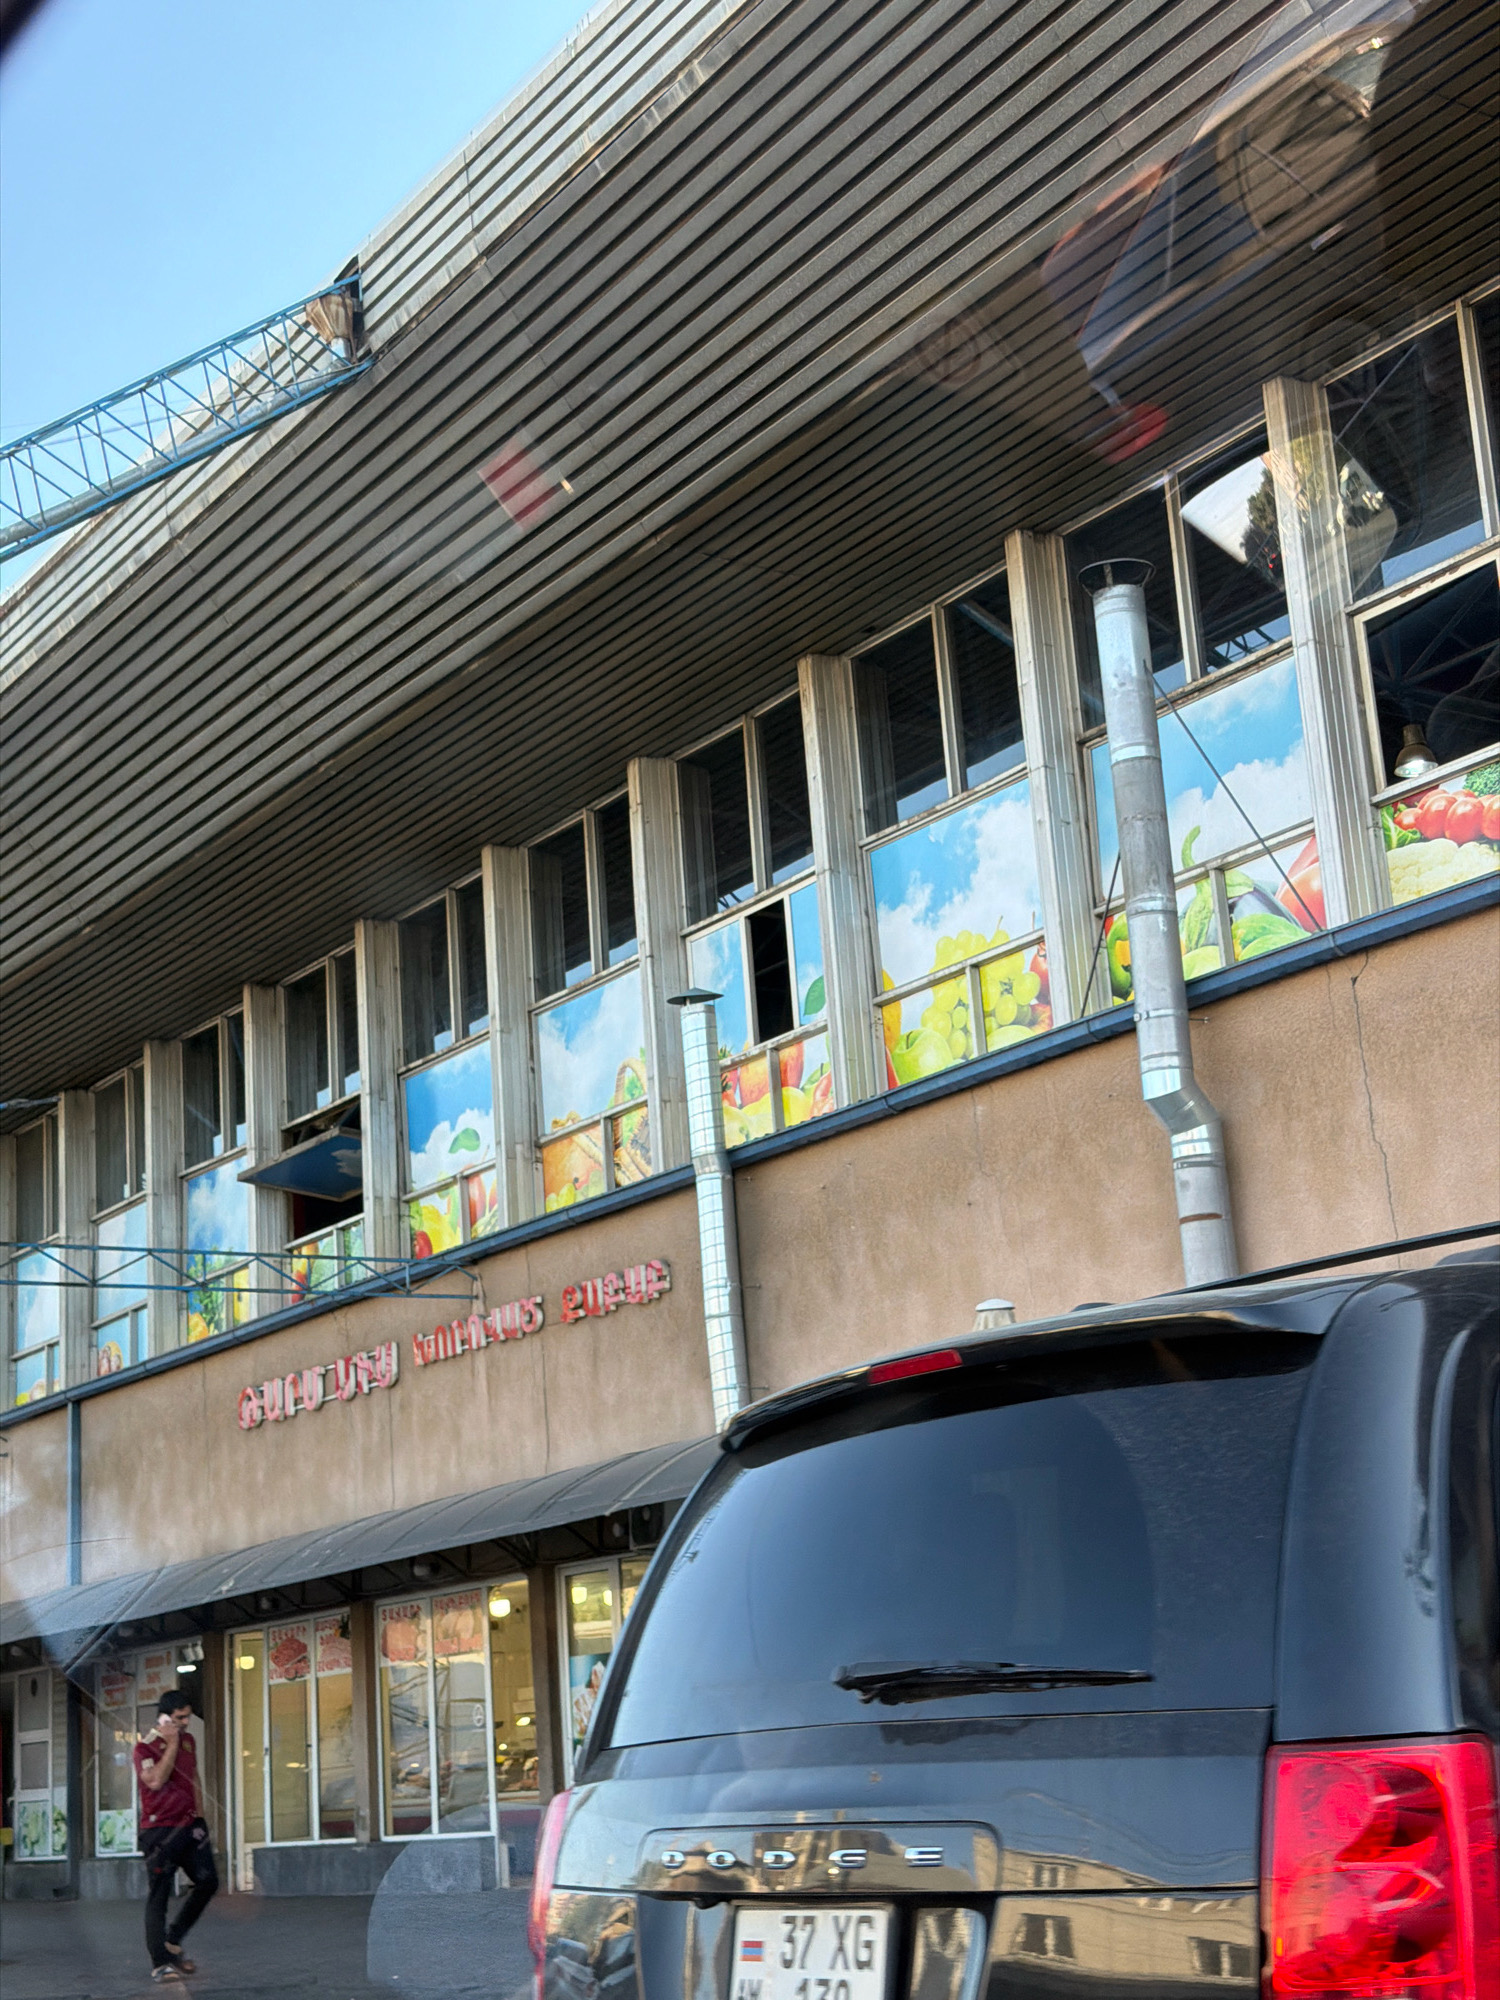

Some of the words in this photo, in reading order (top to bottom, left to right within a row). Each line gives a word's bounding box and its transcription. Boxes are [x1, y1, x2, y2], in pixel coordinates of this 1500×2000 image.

[237, 1365, 326, 1430] ԹԱՐՄ
[335, 1341, 399, 1401] ՄԻՍ
[413, 1295, 544, 1367] ԽՈՐՈՎԱԾ
[561, 1259, 671, 1324] ՔԱԲԱԲ
[661, 1847, 944, 1869] DODGE
[780, 1915, 817, 1969] 37
[829, 1915, 875, 1970] XG
